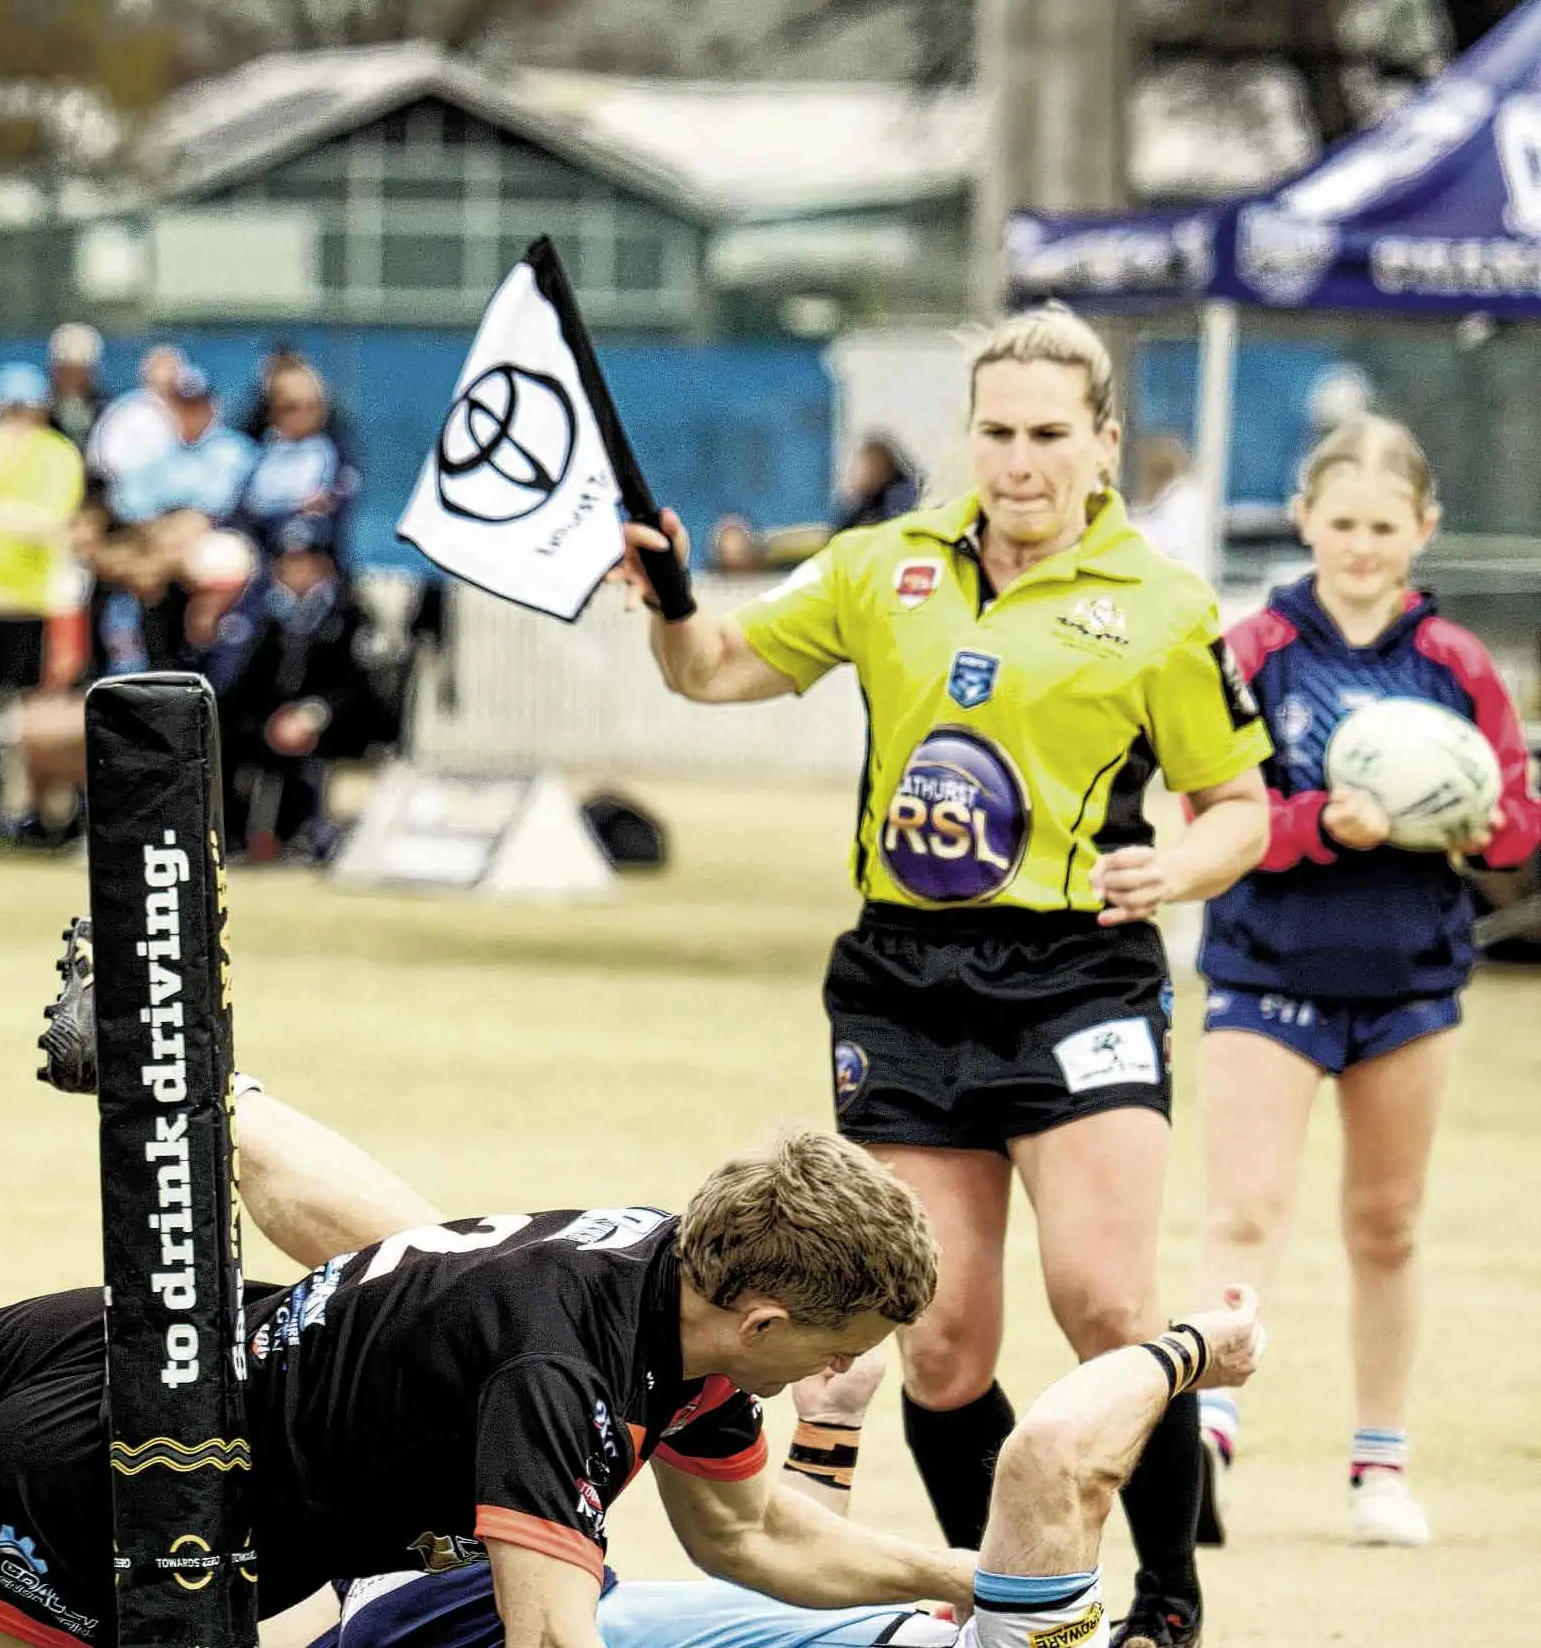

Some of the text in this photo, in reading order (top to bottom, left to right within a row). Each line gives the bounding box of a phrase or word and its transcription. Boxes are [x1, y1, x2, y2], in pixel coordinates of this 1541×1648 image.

[885, 795, 1010, 870] RSL
[136, 829, 200, 1389] to drink driving.
